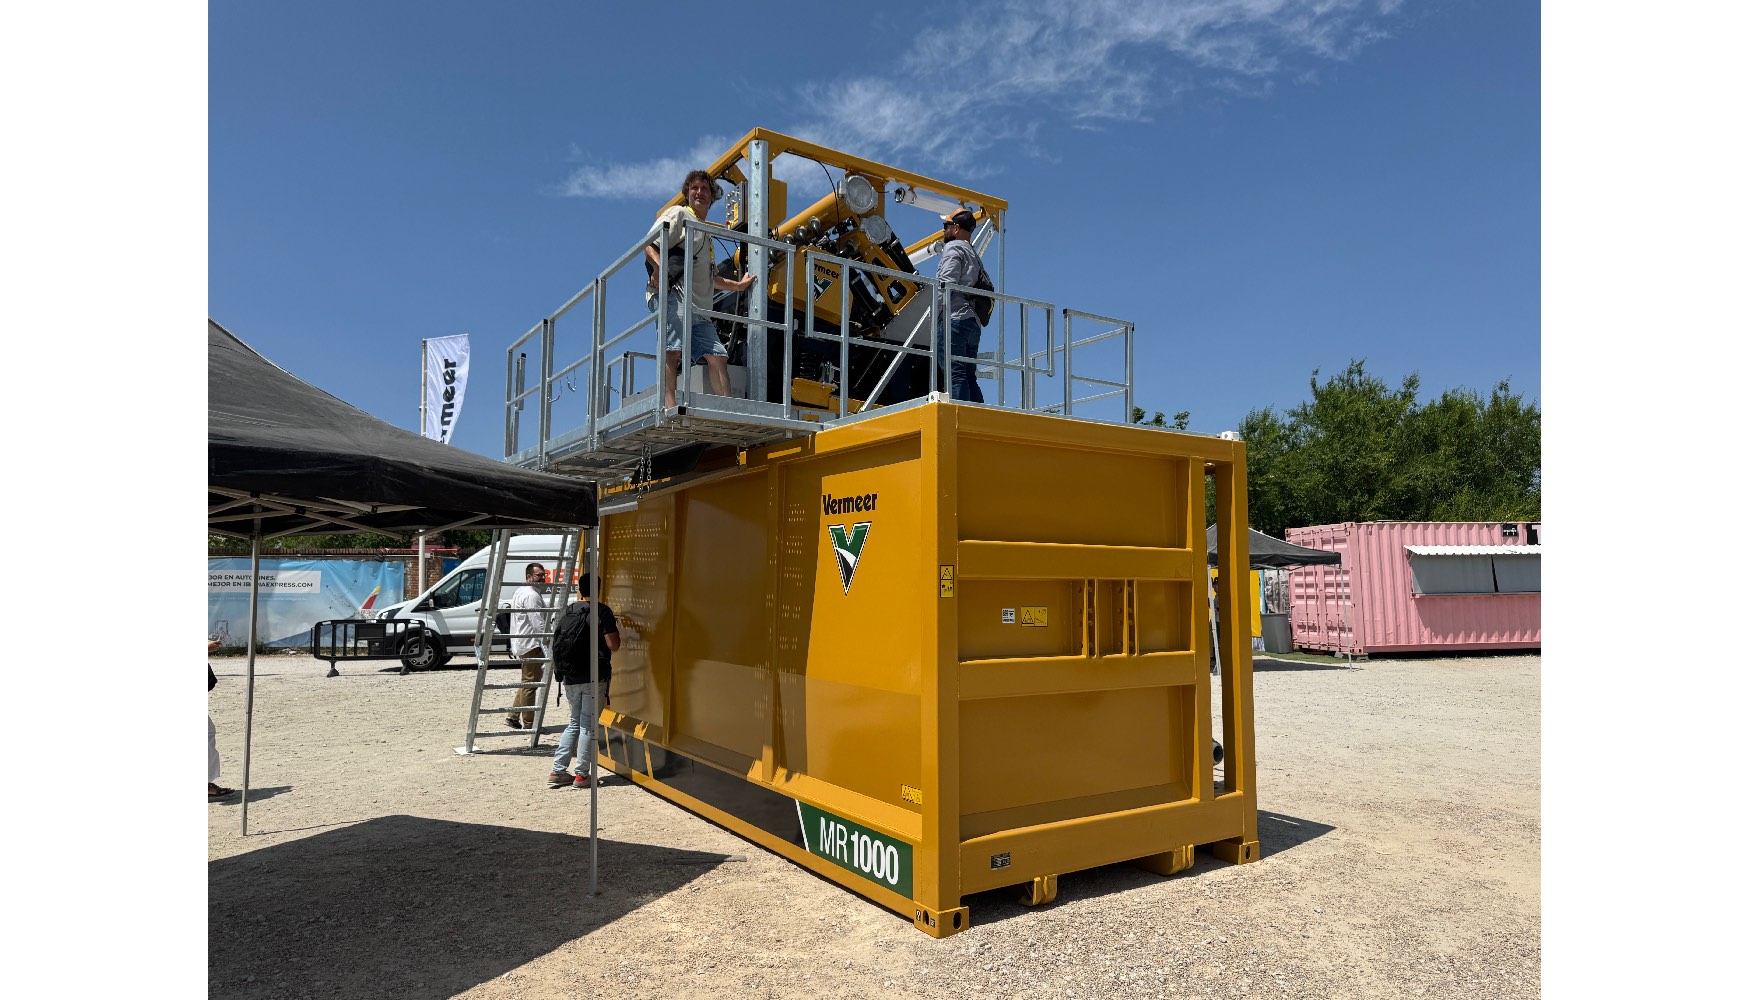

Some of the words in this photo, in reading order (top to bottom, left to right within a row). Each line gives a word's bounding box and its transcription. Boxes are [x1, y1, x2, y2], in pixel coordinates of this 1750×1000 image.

[814, 264, 839, 279] rmeer
[441, 359, 456, 443] rmeer
[823, 494, 877, 515] Vermeer
